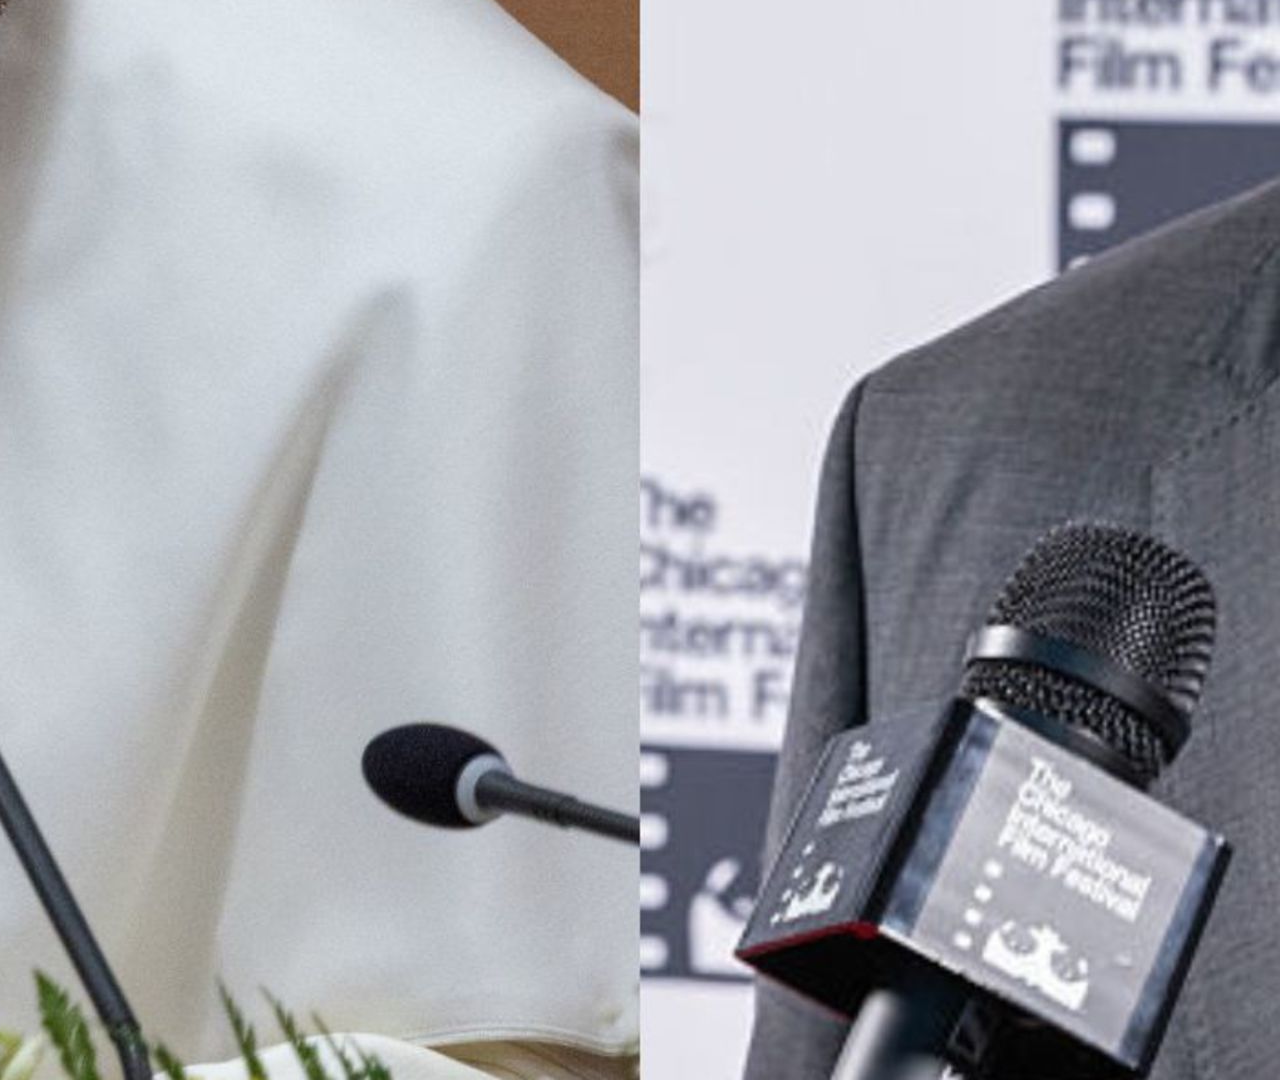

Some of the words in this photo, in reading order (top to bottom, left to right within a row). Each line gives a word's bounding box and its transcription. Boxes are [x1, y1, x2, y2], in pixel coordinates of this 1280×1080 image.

[1058, 35, 1181, 91] Film
[640, 478, 717, 533] he
[1031, 756, 1072, 800] The
